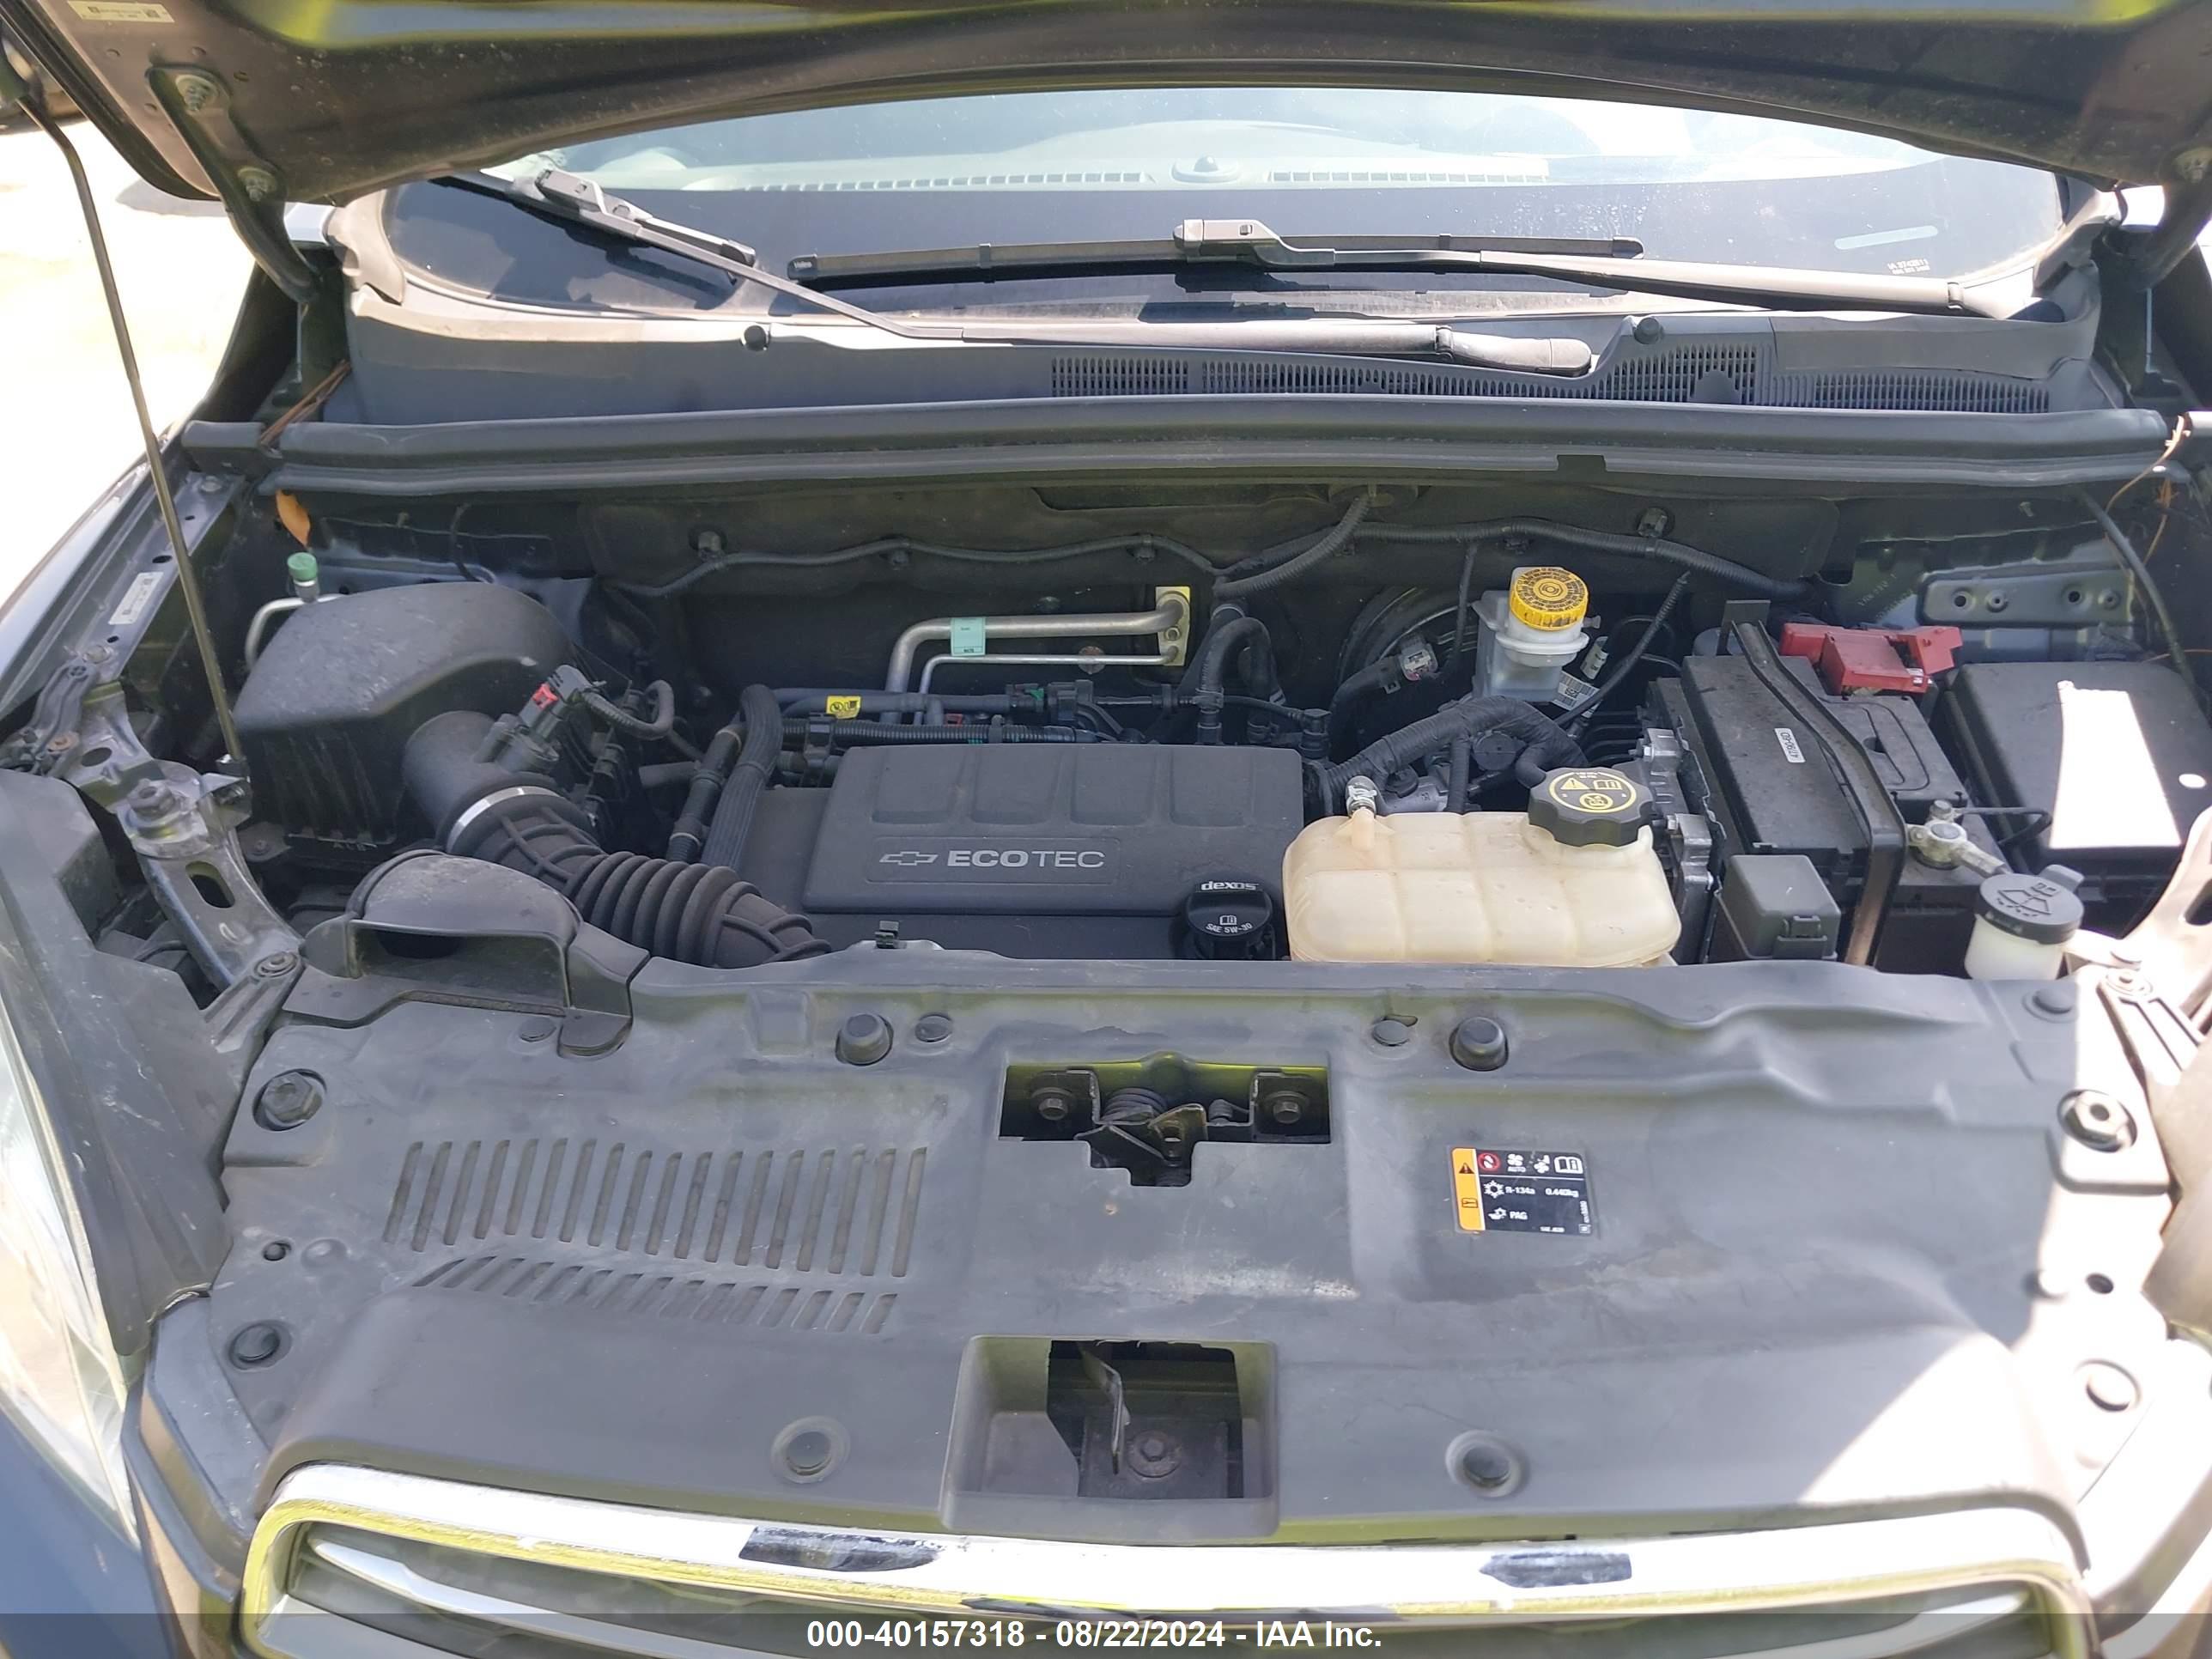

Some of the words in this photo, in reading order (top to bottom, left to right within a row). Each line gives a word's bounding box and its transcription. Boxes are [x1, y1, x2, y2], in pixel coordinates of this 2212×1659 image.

[947, 850, 1105, 867] ECOTEC
[1201, 881, 1260, 890] dexos
[1206, 923, 1222, 933] SAE
[1224, 922, 1253, 933] 5W-30
[1509, 1211, 1528, 1220] PAG
